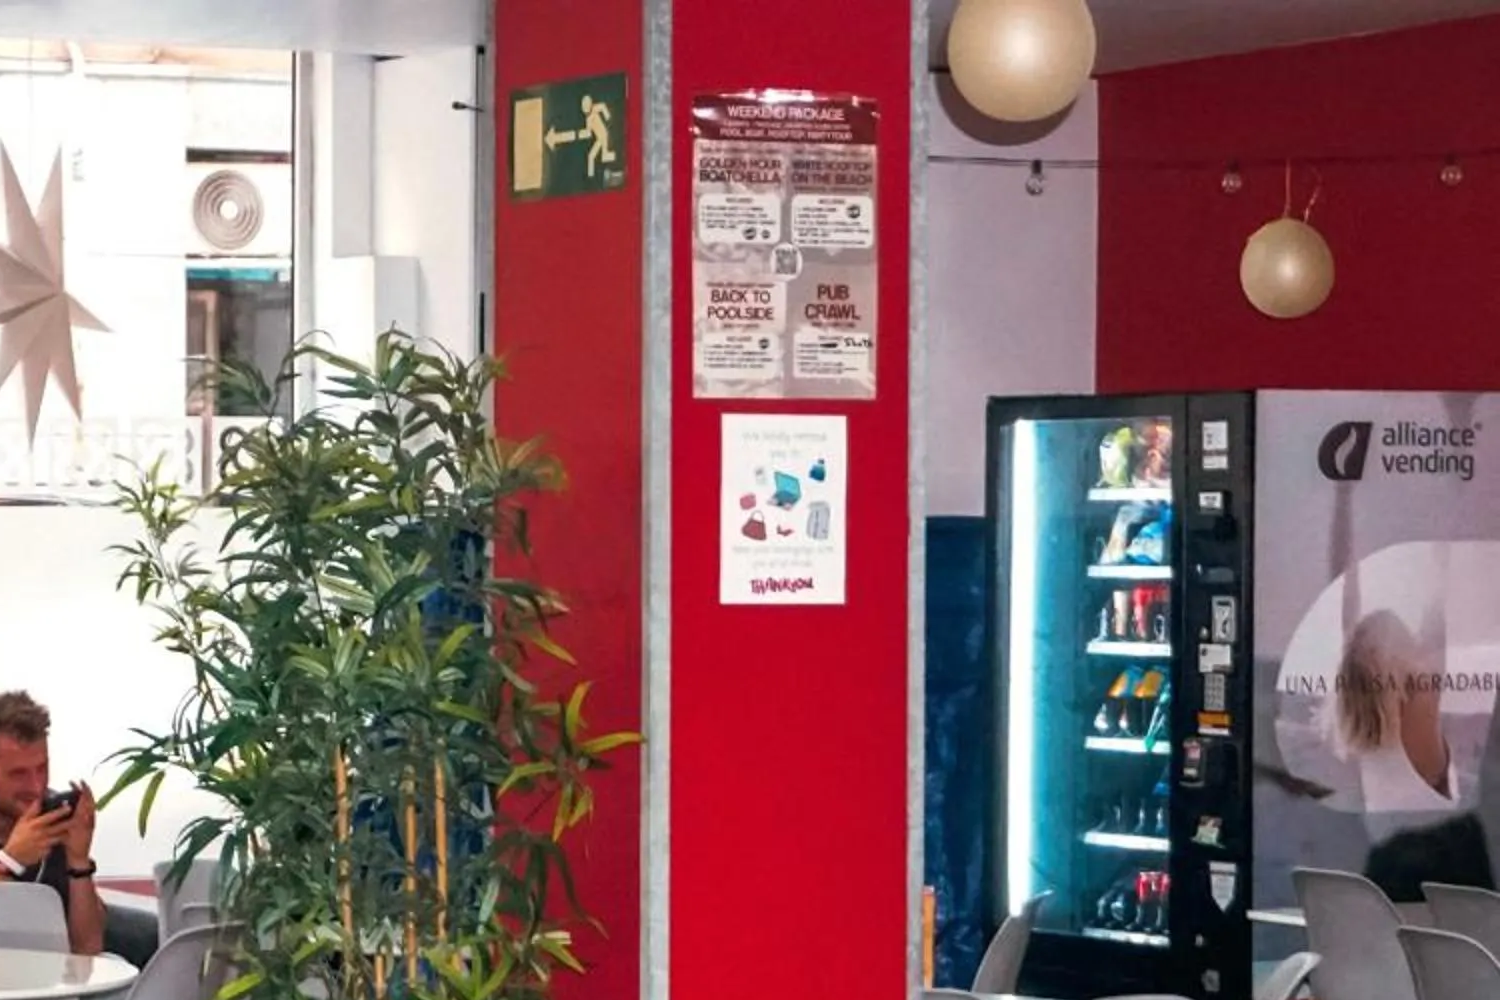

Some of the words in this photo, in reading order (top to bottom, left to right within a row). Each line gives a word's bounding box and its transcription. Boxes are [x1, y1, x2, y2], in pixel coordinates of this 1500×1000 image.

[727, 105, 785, 120] WEEKEND
[788, 107, 845, 121] PACKAGE
[710, 289, 747, 303] BACK
[753, 290, 771, 303] TO
[817, 284, 850, 300] PUB
[707, 306, 774, 321] POOLSIDE
[804, 303, 861, 321] CRAWL
[1382, 421, 1475, 447] alliance
[1381, 447, 1475, 481] vending
[1286, 674, 1327, 695] UNA
